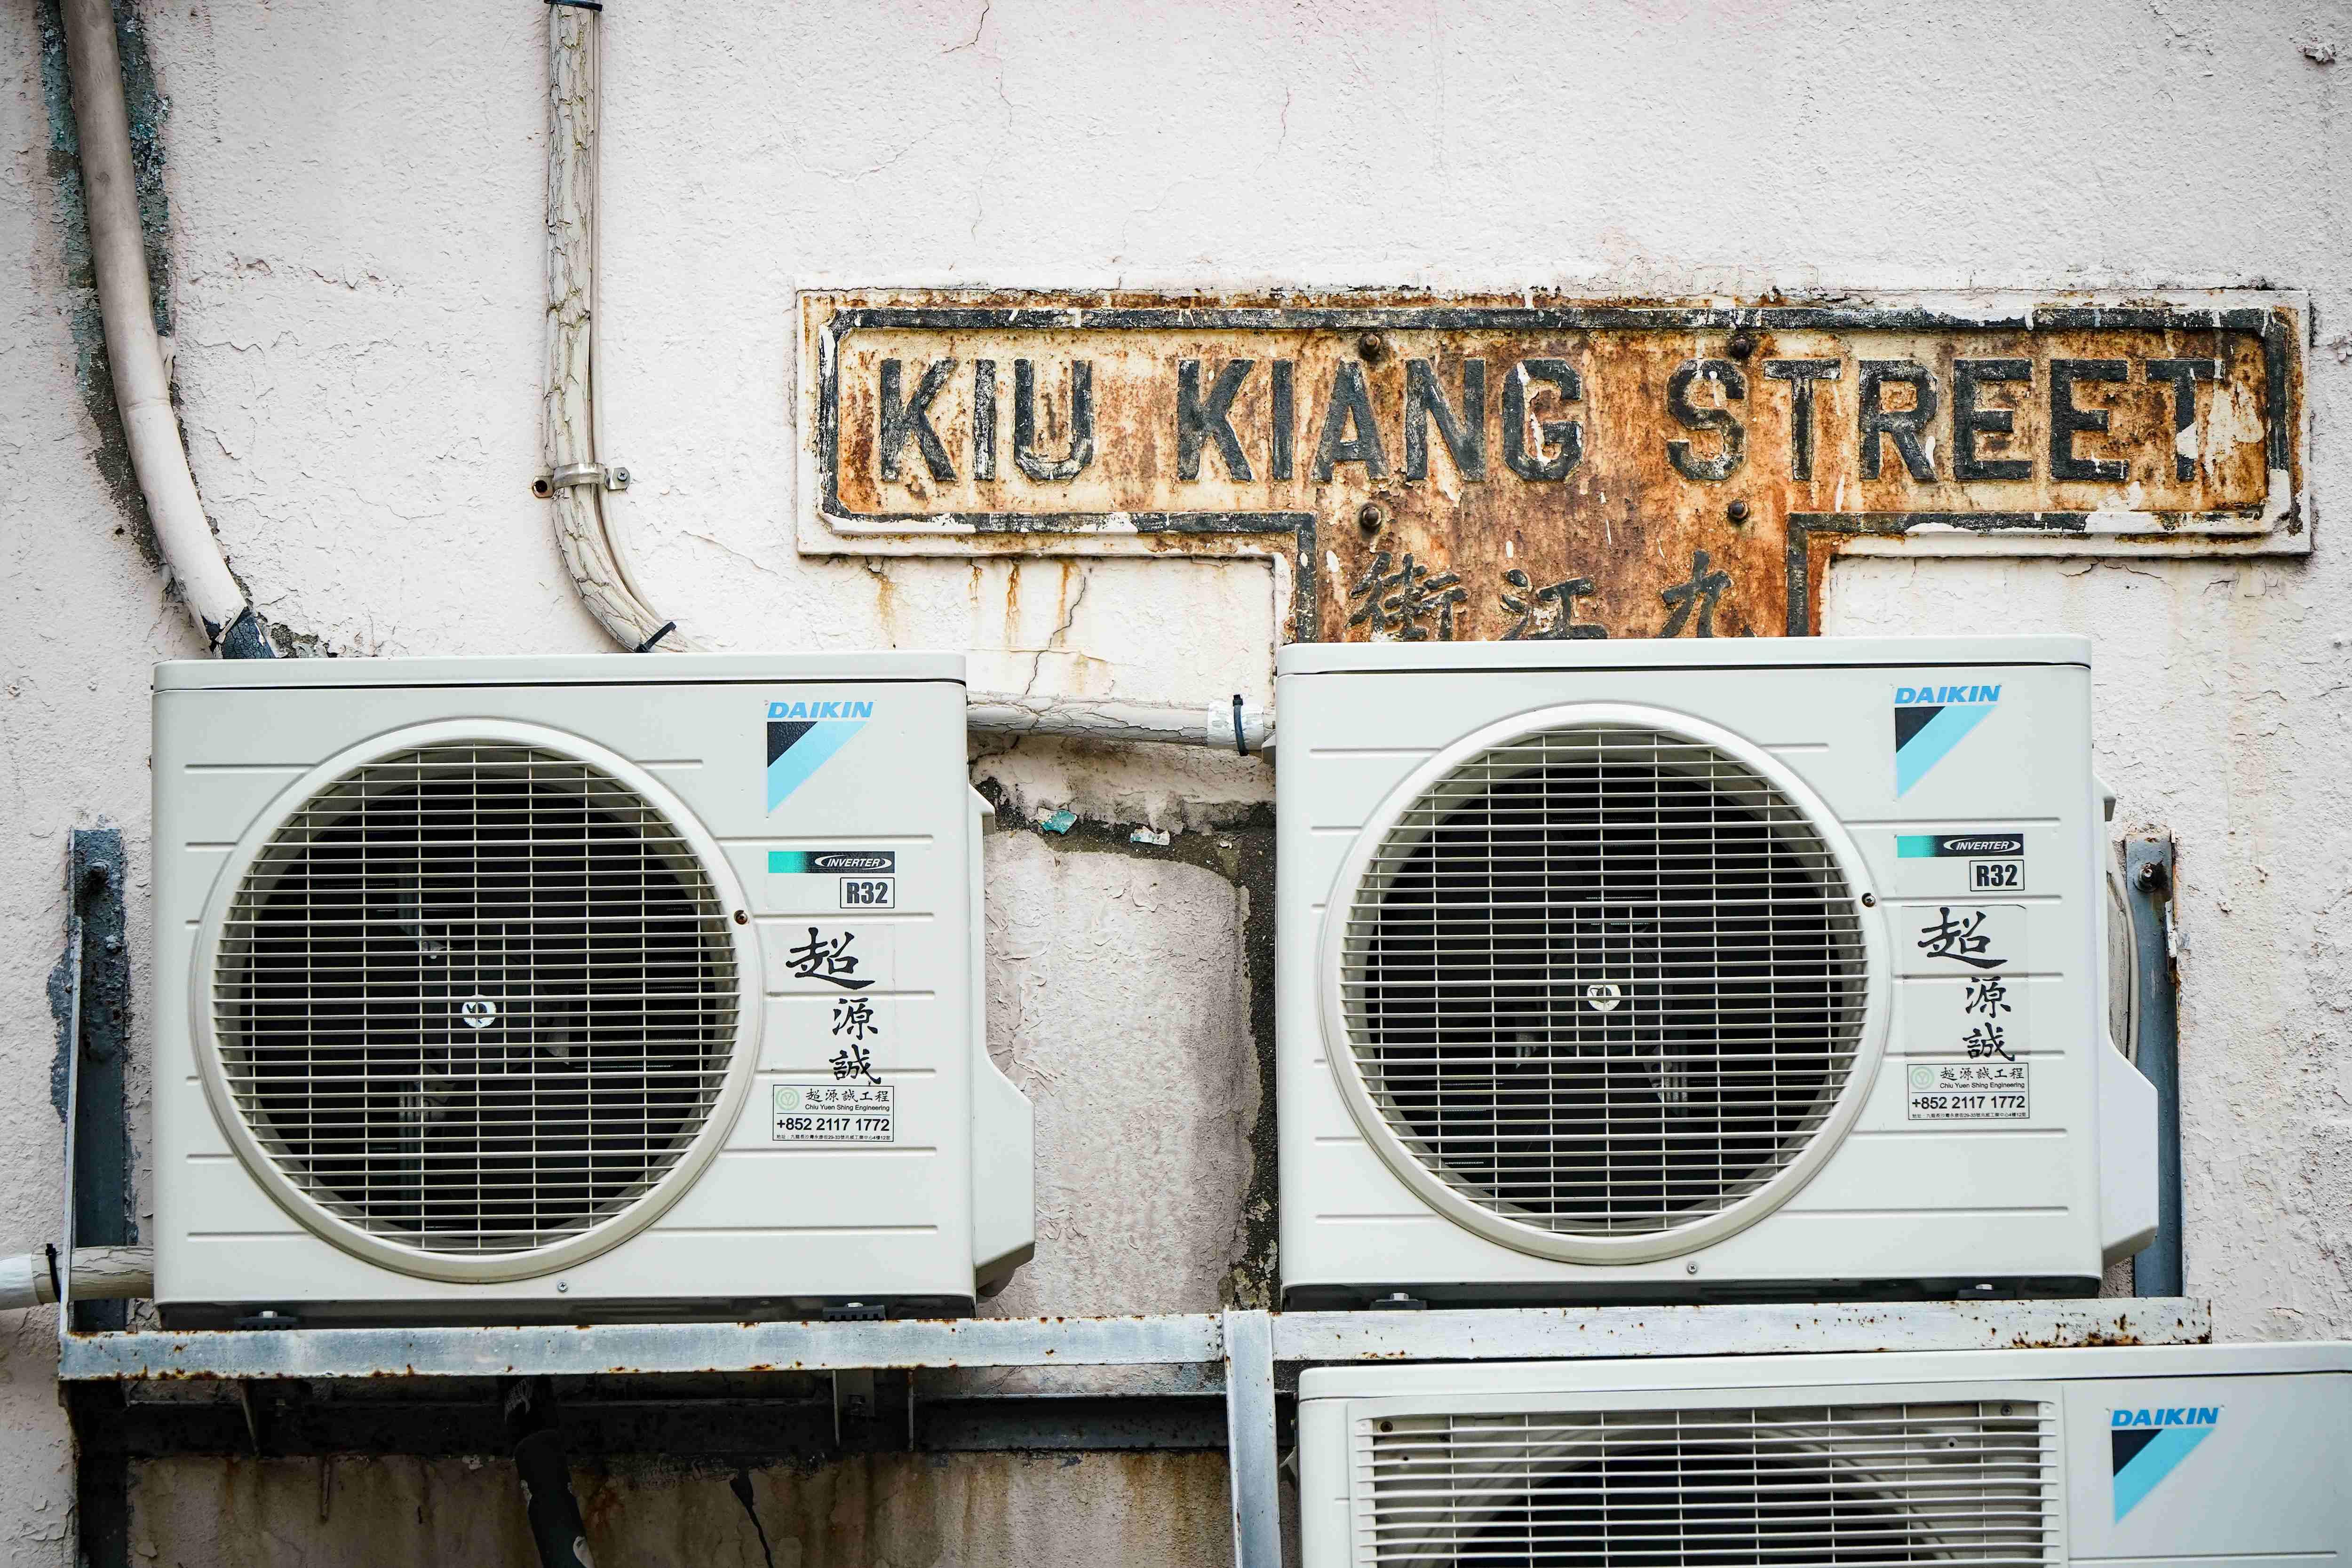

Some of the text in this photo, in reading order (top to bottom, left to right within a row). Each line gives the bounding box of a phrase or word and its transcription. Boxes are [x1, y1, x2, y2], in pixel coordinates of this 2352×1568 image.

[879, 357, 2225, 483] KIU KIANG STREET
[1894, 686, 2001, 704] DAIKIN
[768, 701, 874, 719] DAIKIN
[1955, 840, 2010, 852] INVERTER
[826, 857, 882, 868] INVERTER
[1976, 864, 2018, 887] R32
[847, 882, 888, 904] R32
[1912, 1095, 2025, 1109] +852 2117 1772
[777, 1117, 890, 1131] +852 2117 1772
[2111, 1408, 2219, 1427] DAIKIN
